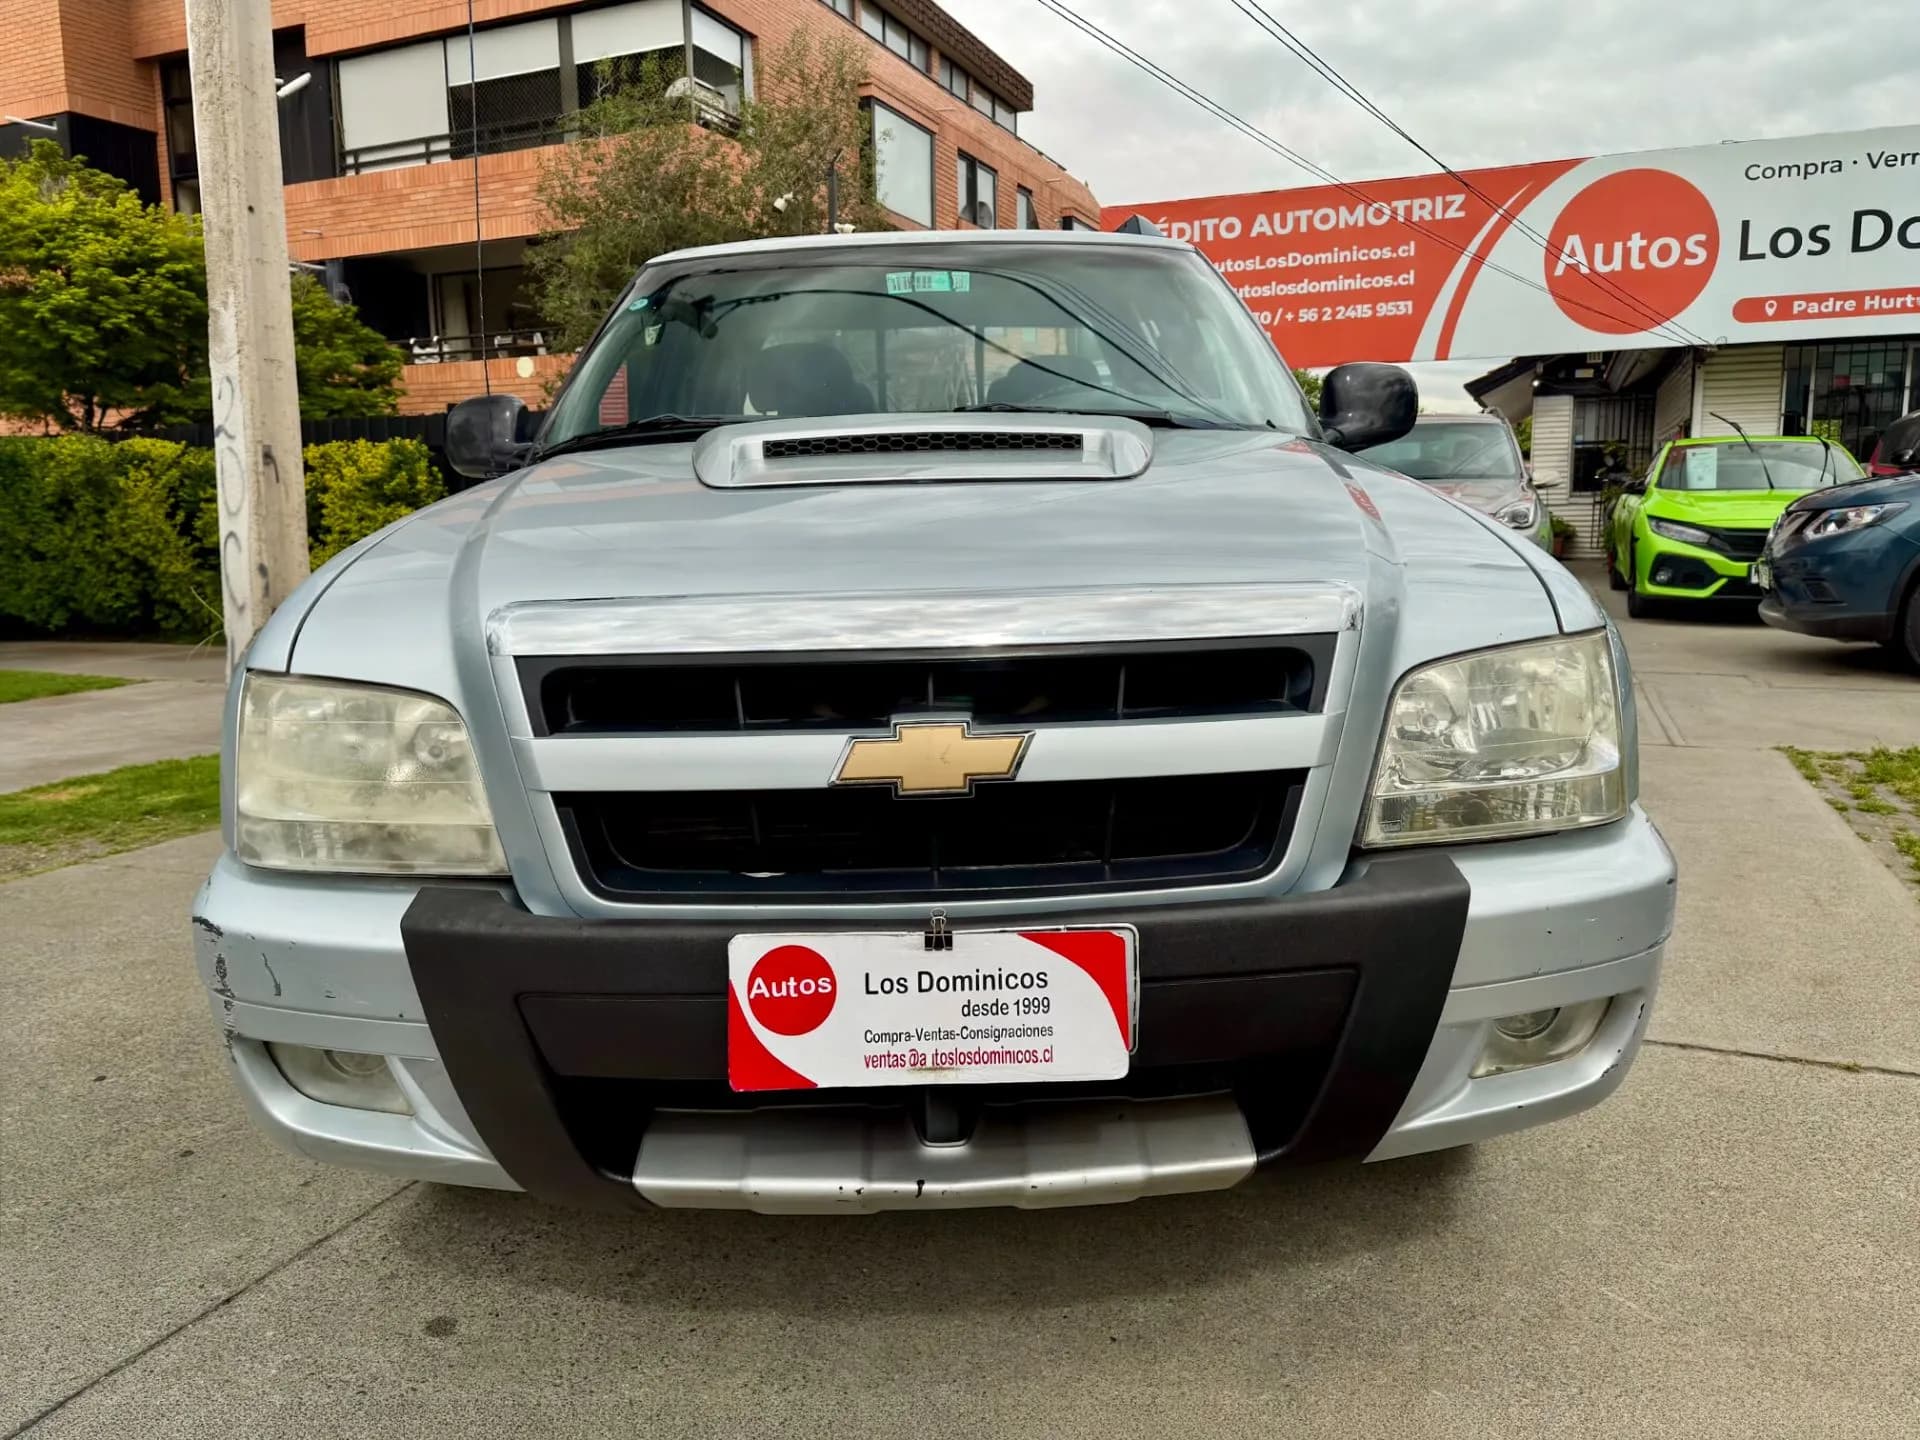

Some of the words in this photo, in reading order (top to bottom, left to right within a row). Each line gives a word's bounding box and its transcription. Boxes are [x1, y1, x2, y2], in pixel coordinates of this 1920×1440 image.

[1744, 159, 1843, 181] Compra
[1155, 216, 1242, 242] ÉDITO
[1250, 194, 1466, 237] AUTOMOTRIZ
[1739, 219, 1831, 261] Los
[1213, 241, 1415, 273] utosLosDominicos.cl
[1553, 231, 1708, 277] Autos
[1233, 269, 1415, 298] utoslosdominicos.cl
[1298, 308, 1319, 323] 56
[1322, 307, 1333, 321] 2
[1335, 303, 1373, 320] 2415
[1376, 300, 1413, 317] 9531
[1793, 297, 1857, 315] Padre
[749, 976, 833, 1000] Autos
[864, 972, 908, 995] Los
[917, 968, 1049, 993] Dominicos
[961, 998, 1009, 1017] desde
[1013, 997, 1051, 1016] 1999
[864, 1024, 1054, 1046] Compra-Ventas-Consignaciones
